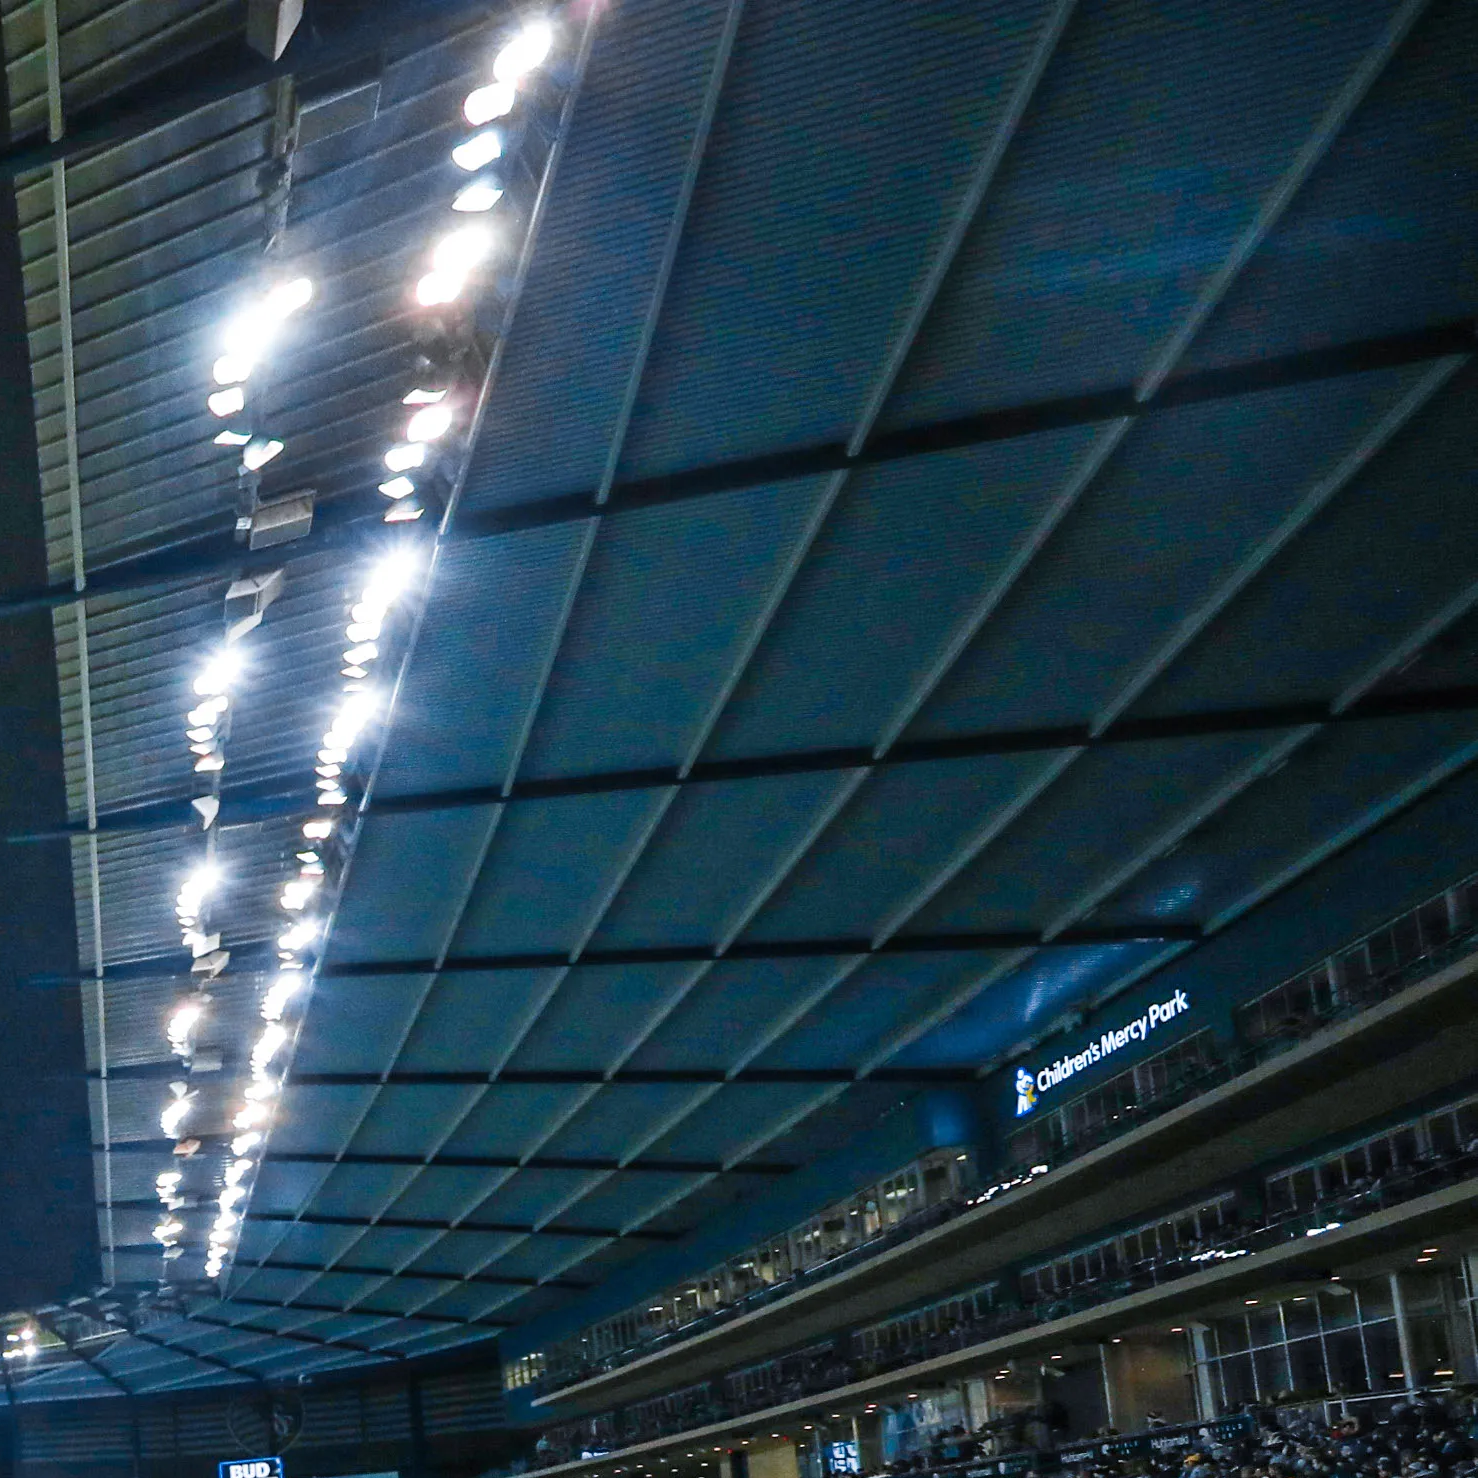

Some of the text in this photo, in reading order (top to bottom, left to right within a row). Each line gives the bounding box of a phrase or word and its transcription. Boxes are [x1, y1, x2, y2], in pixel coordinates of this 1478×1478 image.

[1036, 988, 1189, 1092] Children's Mercy Park
